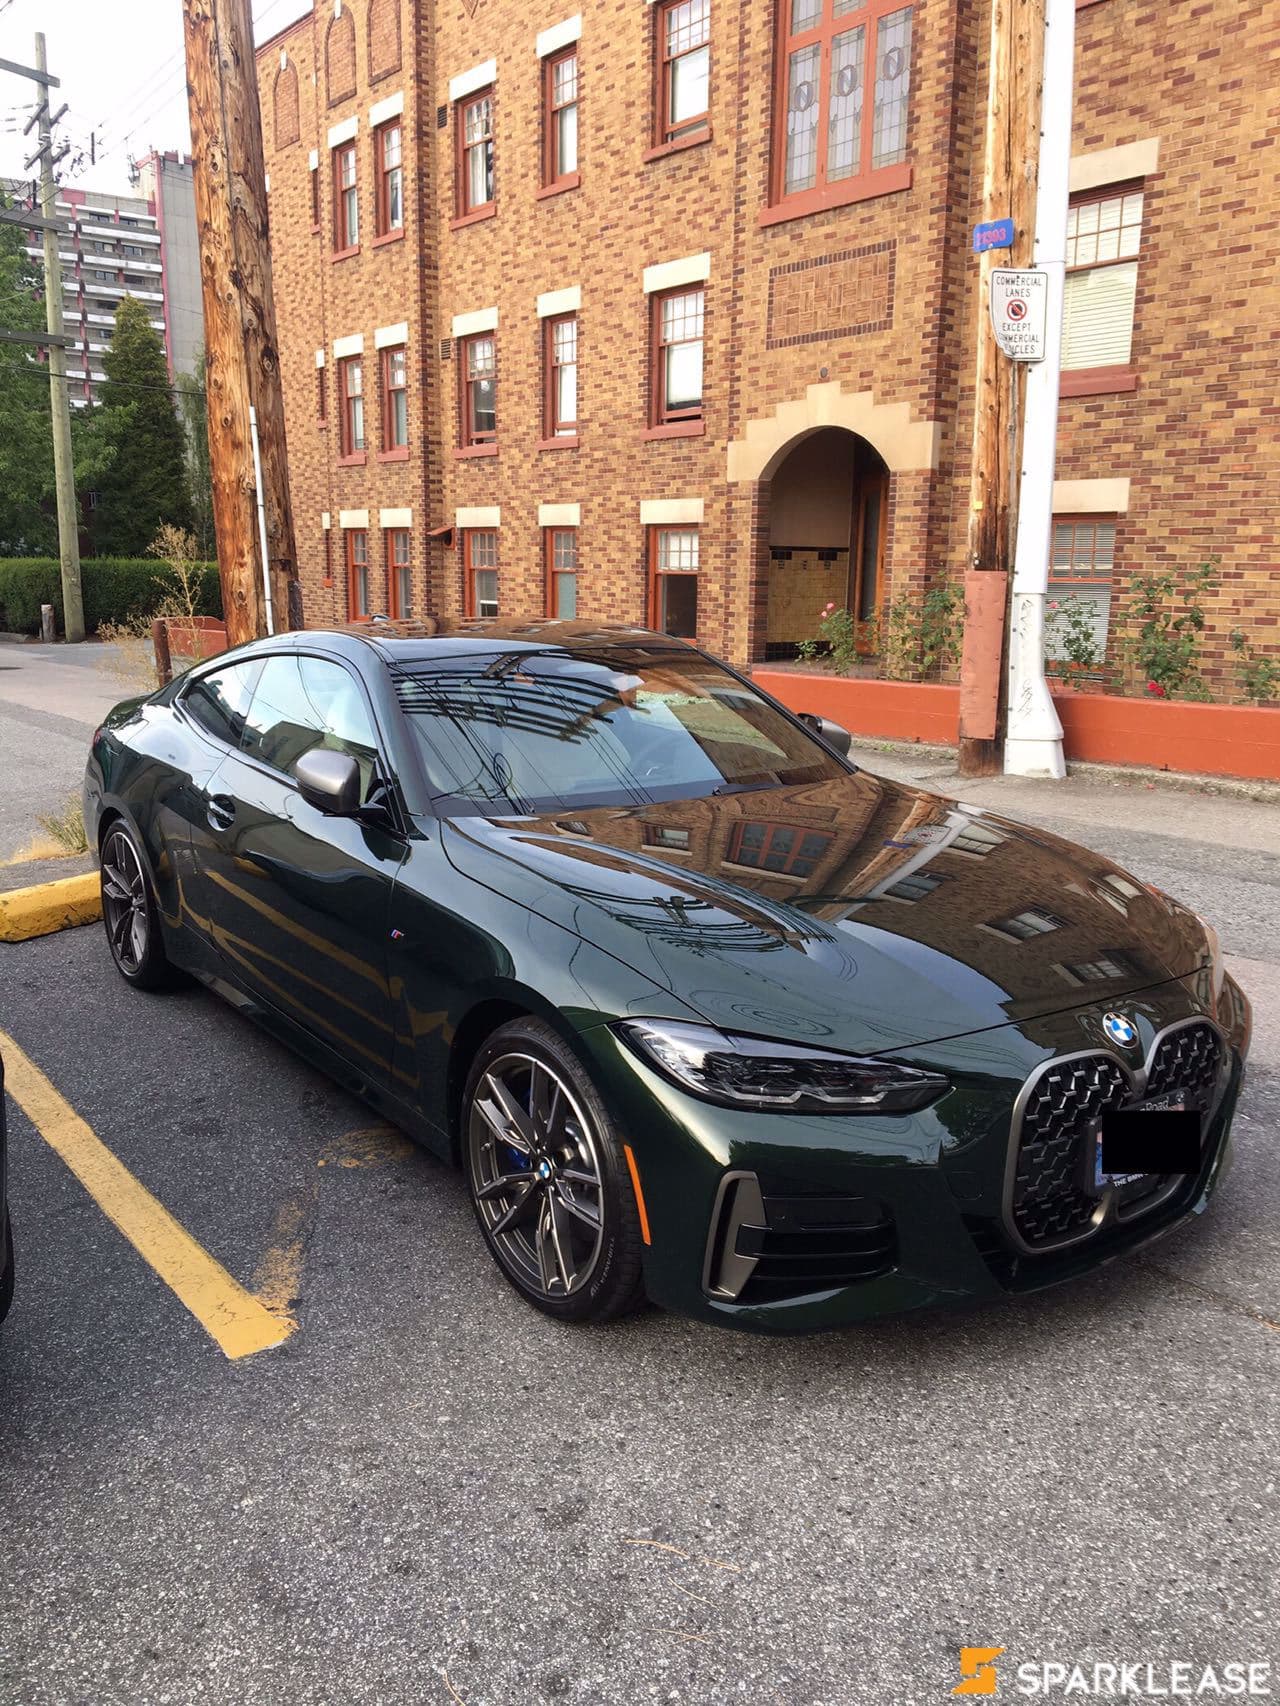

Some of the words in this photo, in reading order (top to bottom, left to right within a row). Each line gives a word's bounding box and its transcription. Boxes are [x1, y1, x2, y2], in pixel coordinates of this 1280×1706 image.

[996, 276, 1042, 286] COMMERCIAL
[1005, 288, 1031, 297] LANES
[1002, 322, 1031, 332] EXCEPT
[1005, 344, 1035, 354] ICLES
[1113, 1177, 1128, 1187] THE
[1127, 1173, 1144, 1183] BMW
